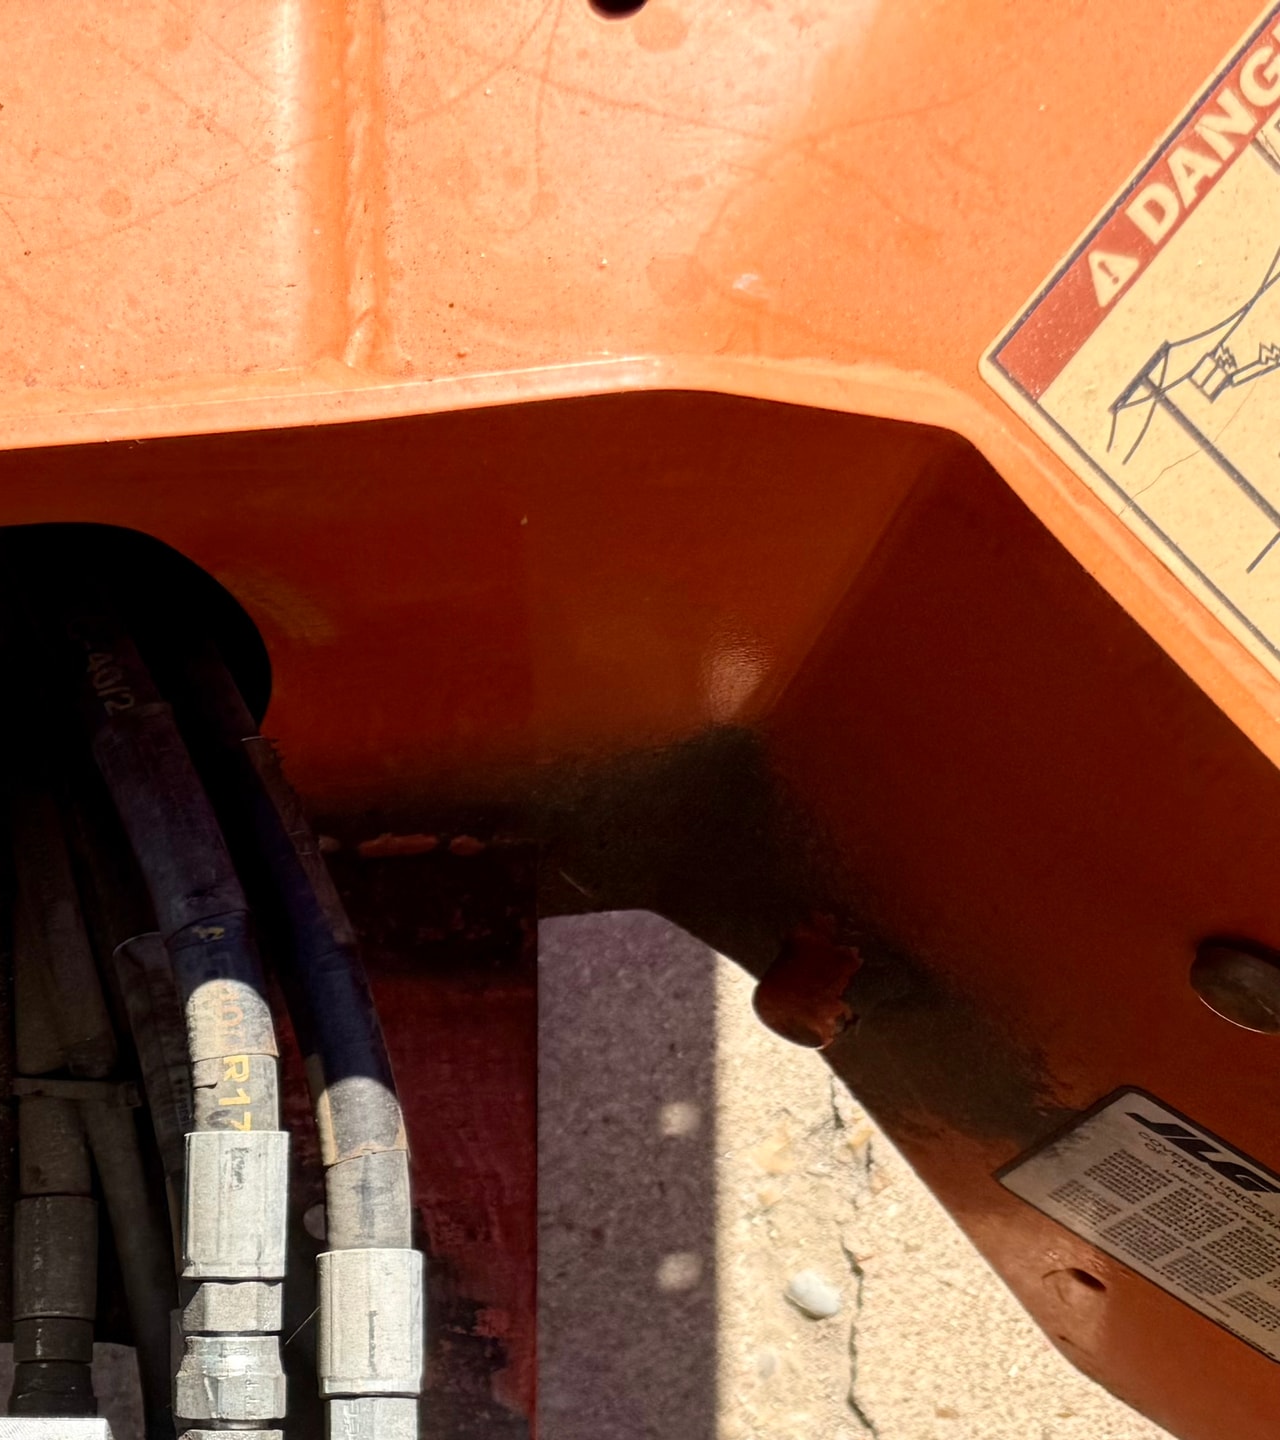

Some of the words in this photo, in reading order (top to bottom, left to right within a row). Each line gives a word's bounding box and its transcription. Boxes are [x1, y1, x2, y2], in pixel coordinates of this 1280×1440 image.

[1126, 27, 1280, 244] DANG
[1124, 1112, 1280, 1194] JLG
[1136, 1130, 1216, 1181] COVERED
[1217, 1181, 1275, 1218] UNDER
[1141, 1142, 1168, 1158] OF
[1169, 1159, 1203, 1181] THE
[1163, 1169, 1212, 1199] UNITED
[1214, 1200, 1265, 1232] STATES
